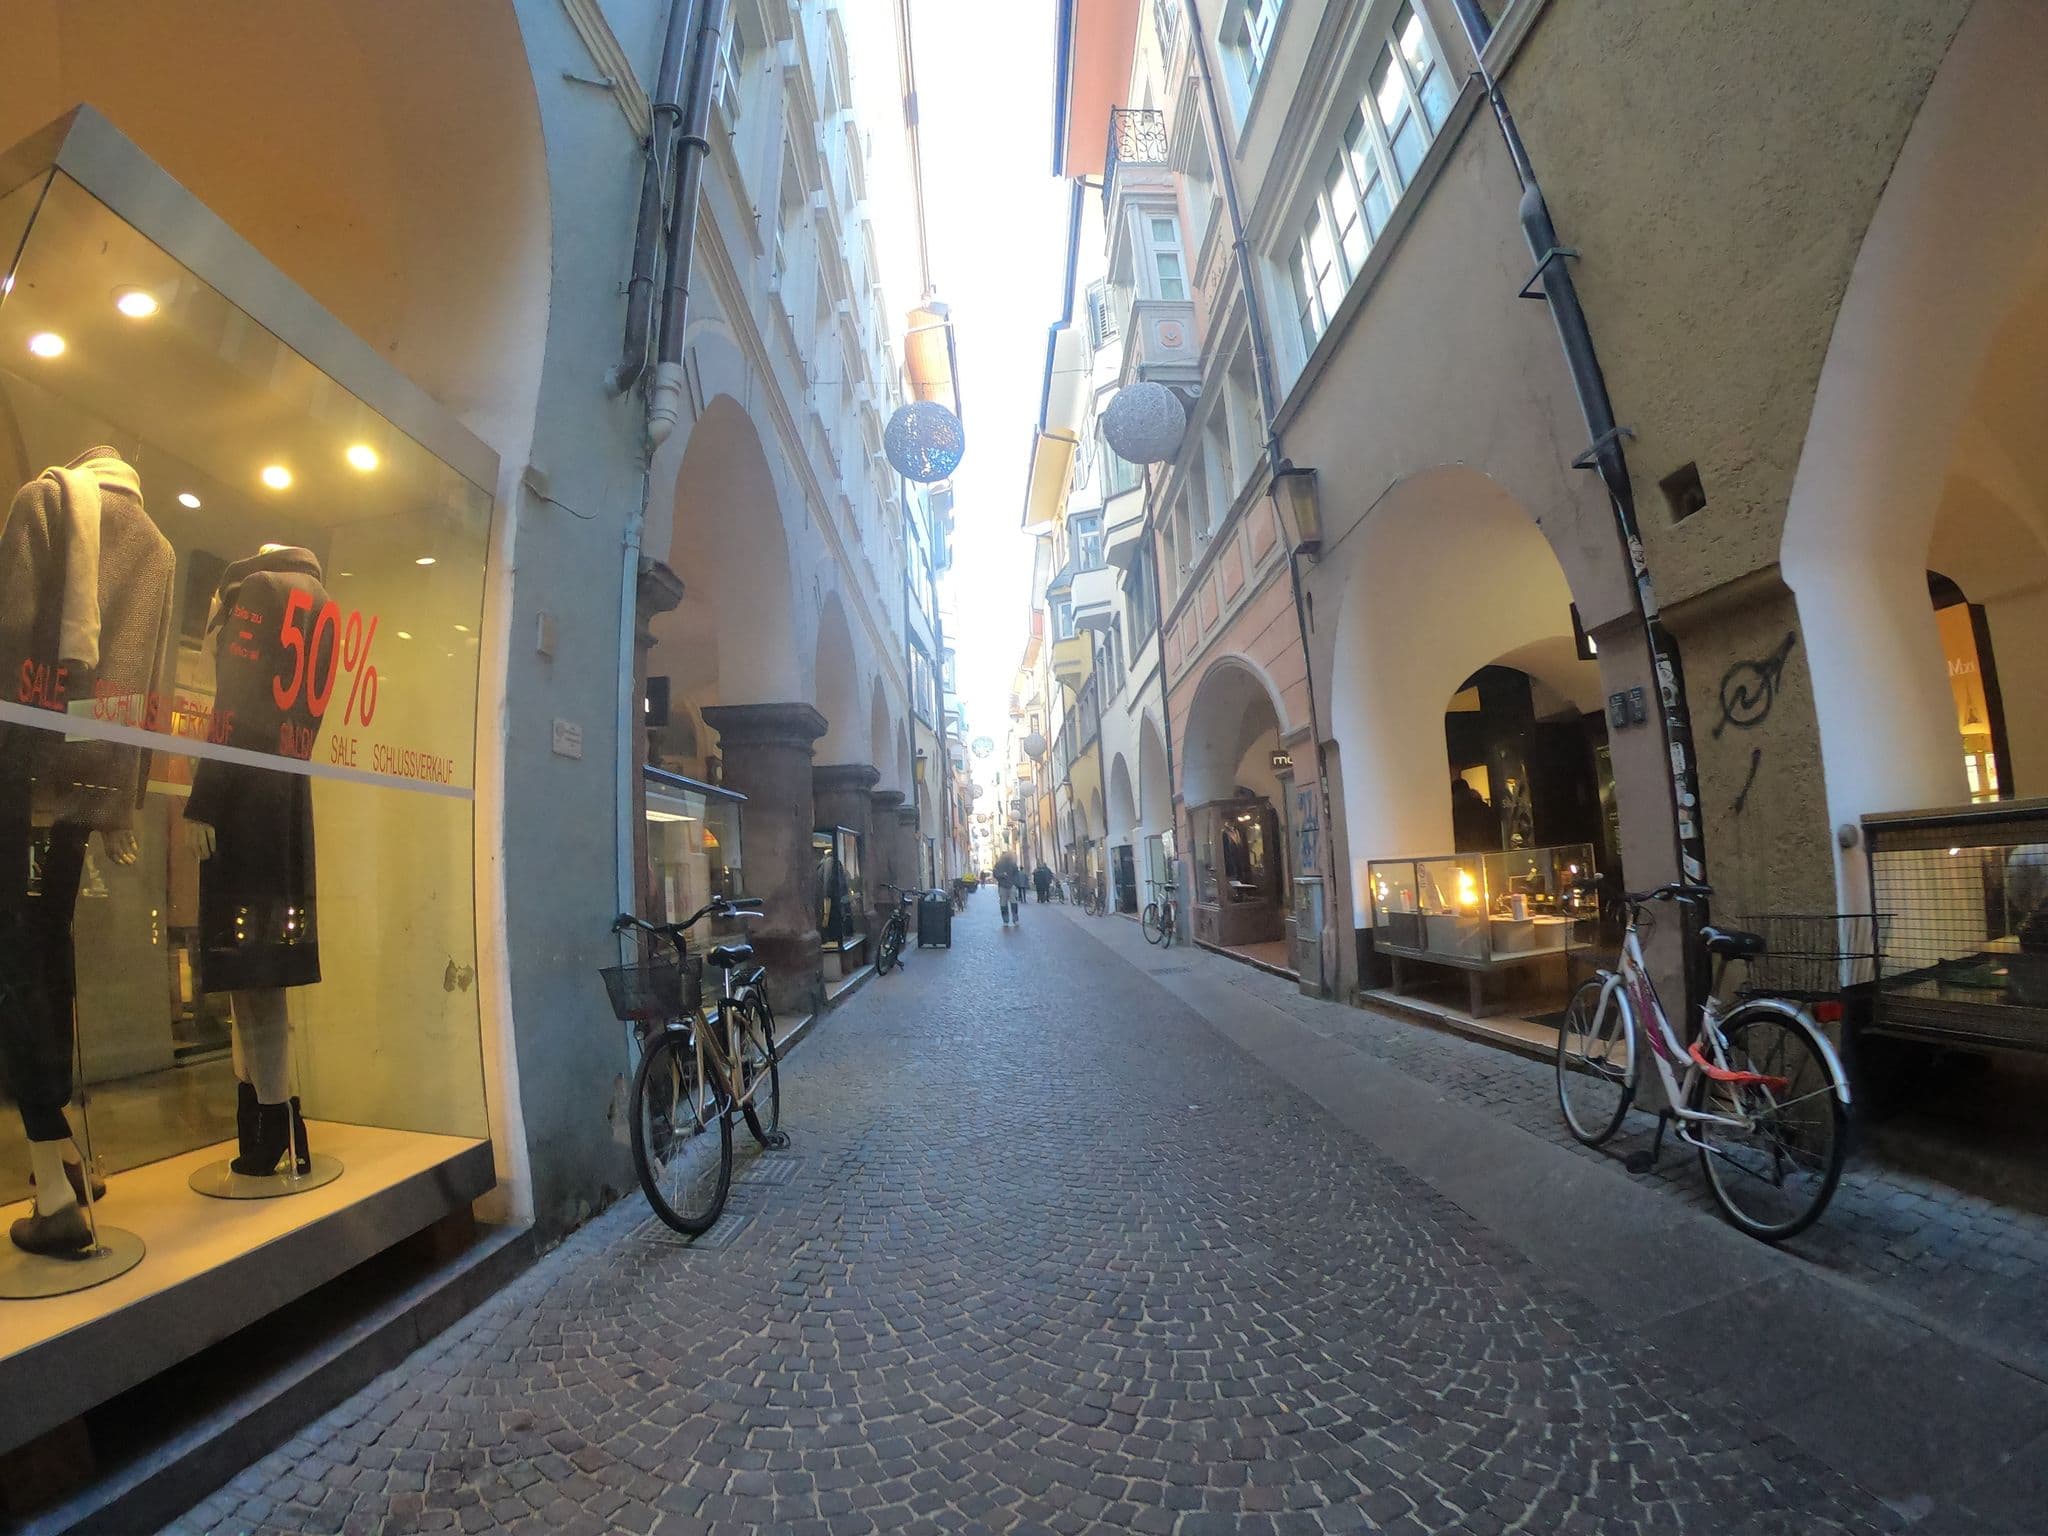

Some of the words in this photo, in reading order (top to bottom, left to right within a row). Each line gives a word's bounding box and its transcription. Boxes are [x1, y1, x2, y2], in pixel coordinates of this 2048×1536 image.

[19, 656, 69, 712] SALE
[272, 587, 379, 728] 50%
[330, 734, 358, 768] SALE
[372, 743, 454, 784] SCHLUSSVERKAUF
